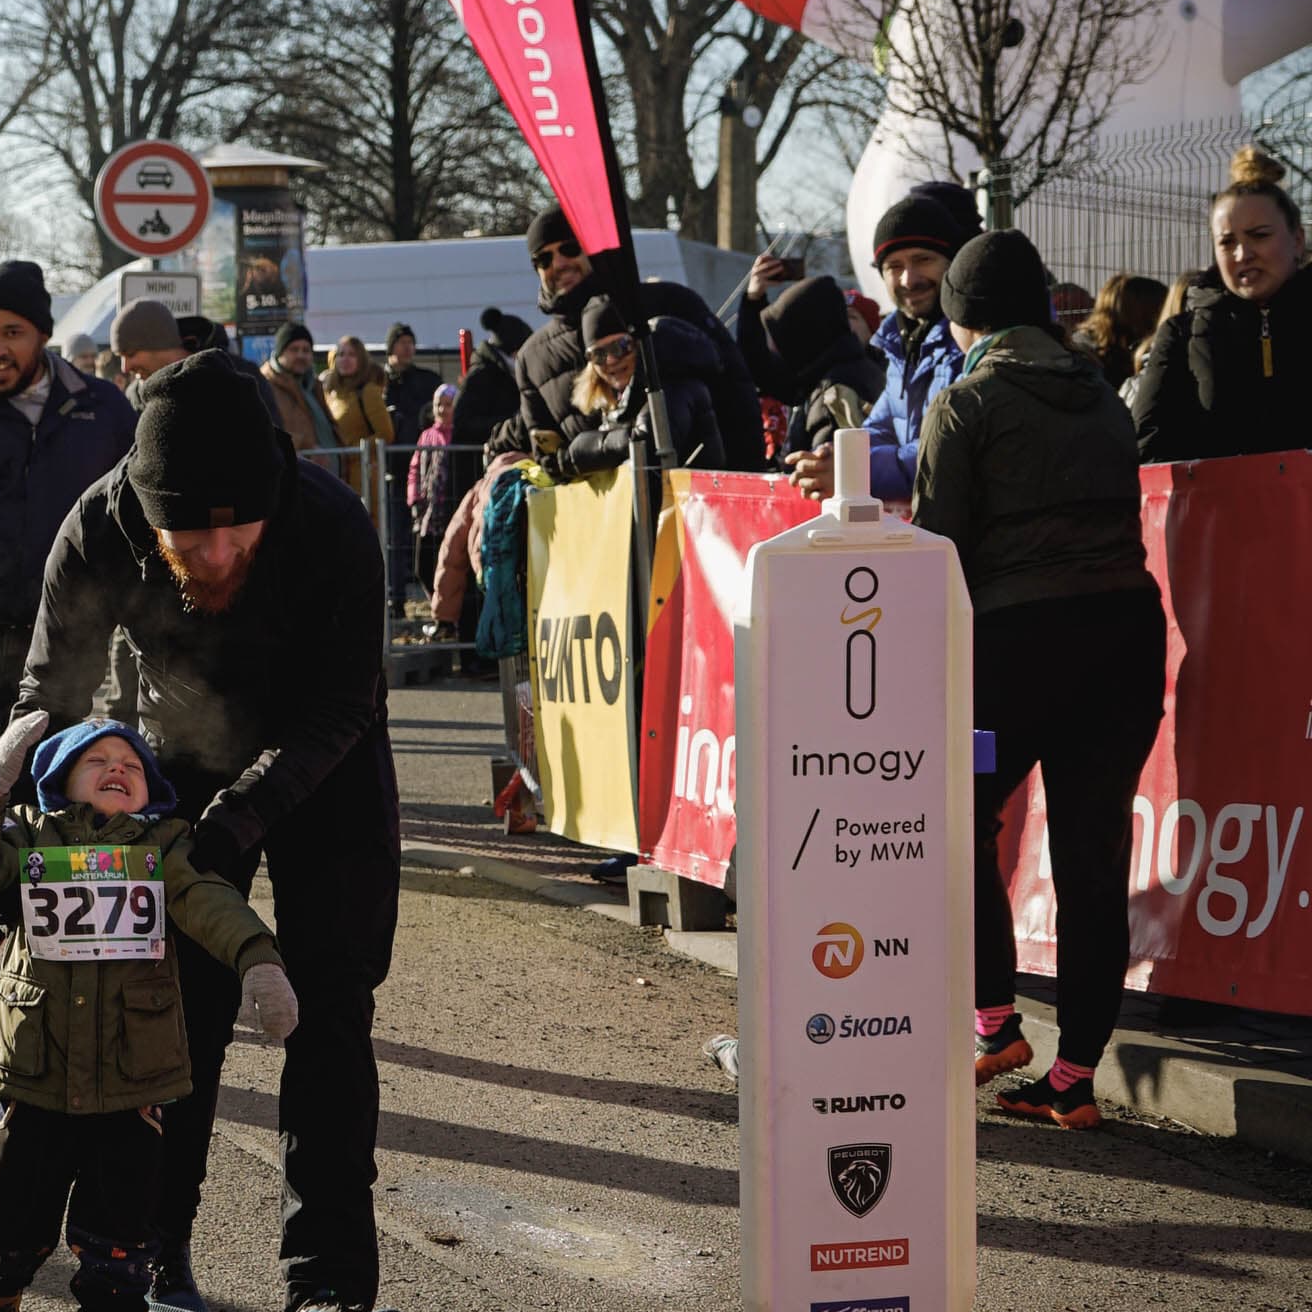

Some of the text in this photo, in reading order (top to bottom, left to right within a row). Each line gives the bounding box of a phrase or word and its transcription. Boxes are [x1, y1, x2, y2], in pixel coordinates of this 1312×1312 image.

[792, 744, 925, 782] innogy
[836, 814, 925, 837] Powered
[835, 840, 924, 868] by MVM
[27, 885, 157, 938] 3279
[874, 938, 909, 957] NN
[839, 1014, 912, 1038] ŠKODA
[830, 1093, 906, 1114] RUNTO
[834, 1148, 886, 1160] PEUGEOT
[816, 1245, 905, 1265] NUTREND
